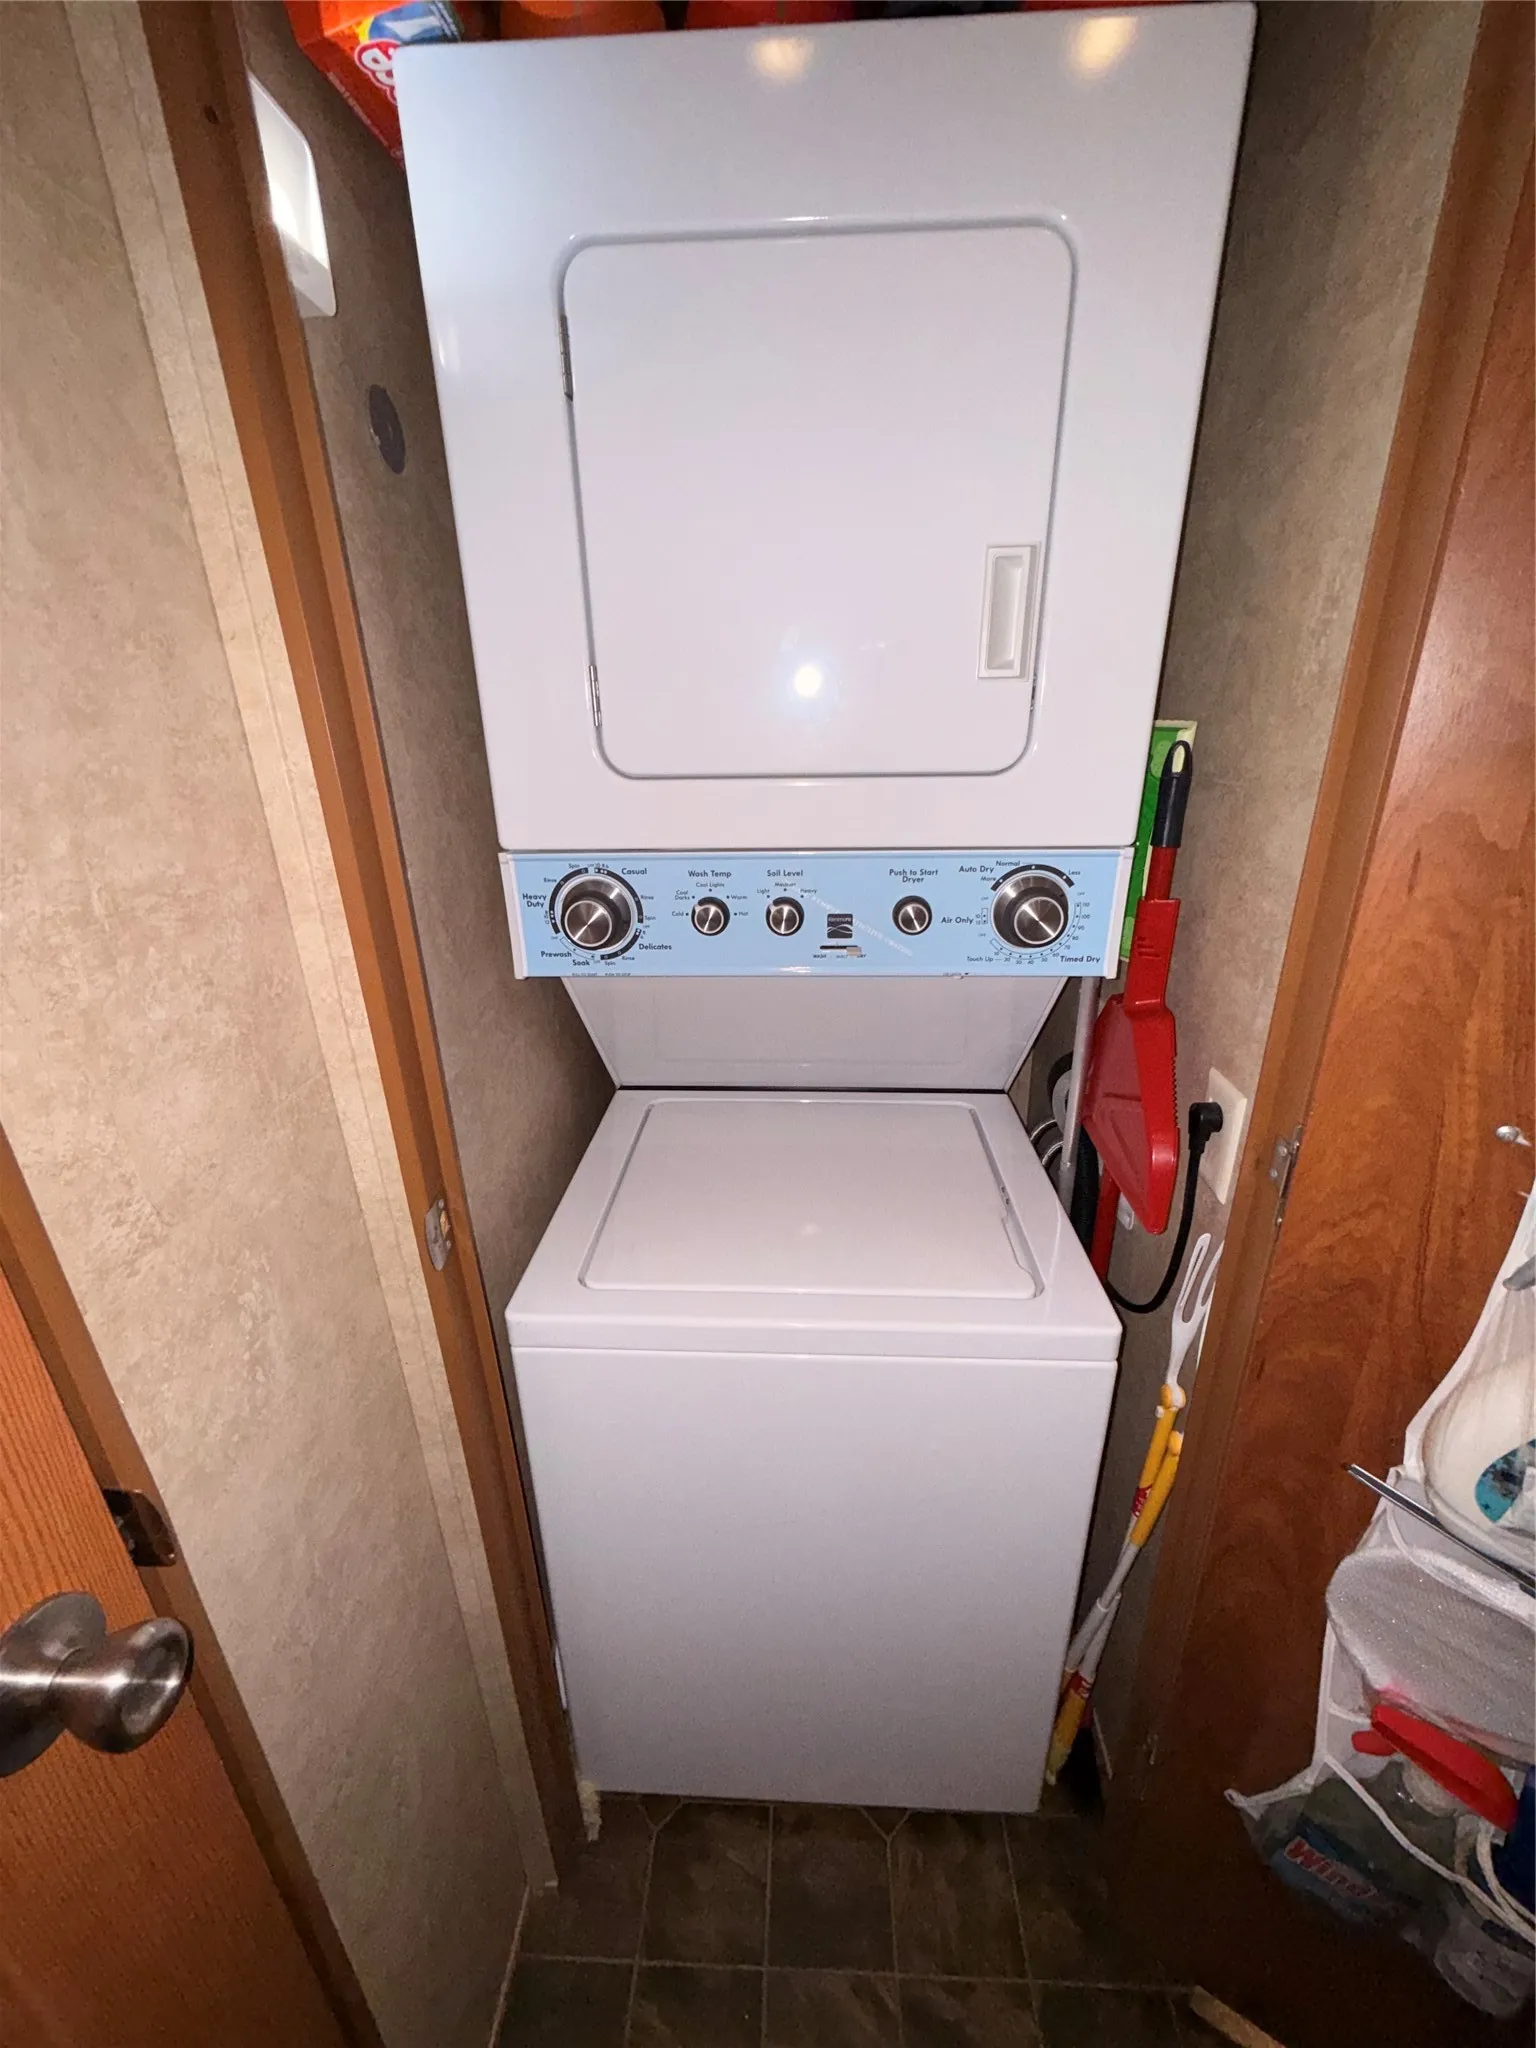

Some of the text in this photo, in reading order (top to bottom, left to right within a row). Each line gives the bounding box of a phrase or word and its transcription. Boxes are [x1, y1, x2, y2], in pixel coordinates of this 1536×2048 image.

[889, 869, 907, 877] Push
[919, 868, 939, 876] Start
[958, 865, 994, 874] Auto Dry
[687, 870, 732, 879] Wash Temp
[902, 876, 924, 884] Dryer
[522, 893, 547, 901] Heavy
[526, 900, 545, 908] Duty
[940, 916, 974, 925] Air Only
[1060, 955, 1084, 963] Timed
